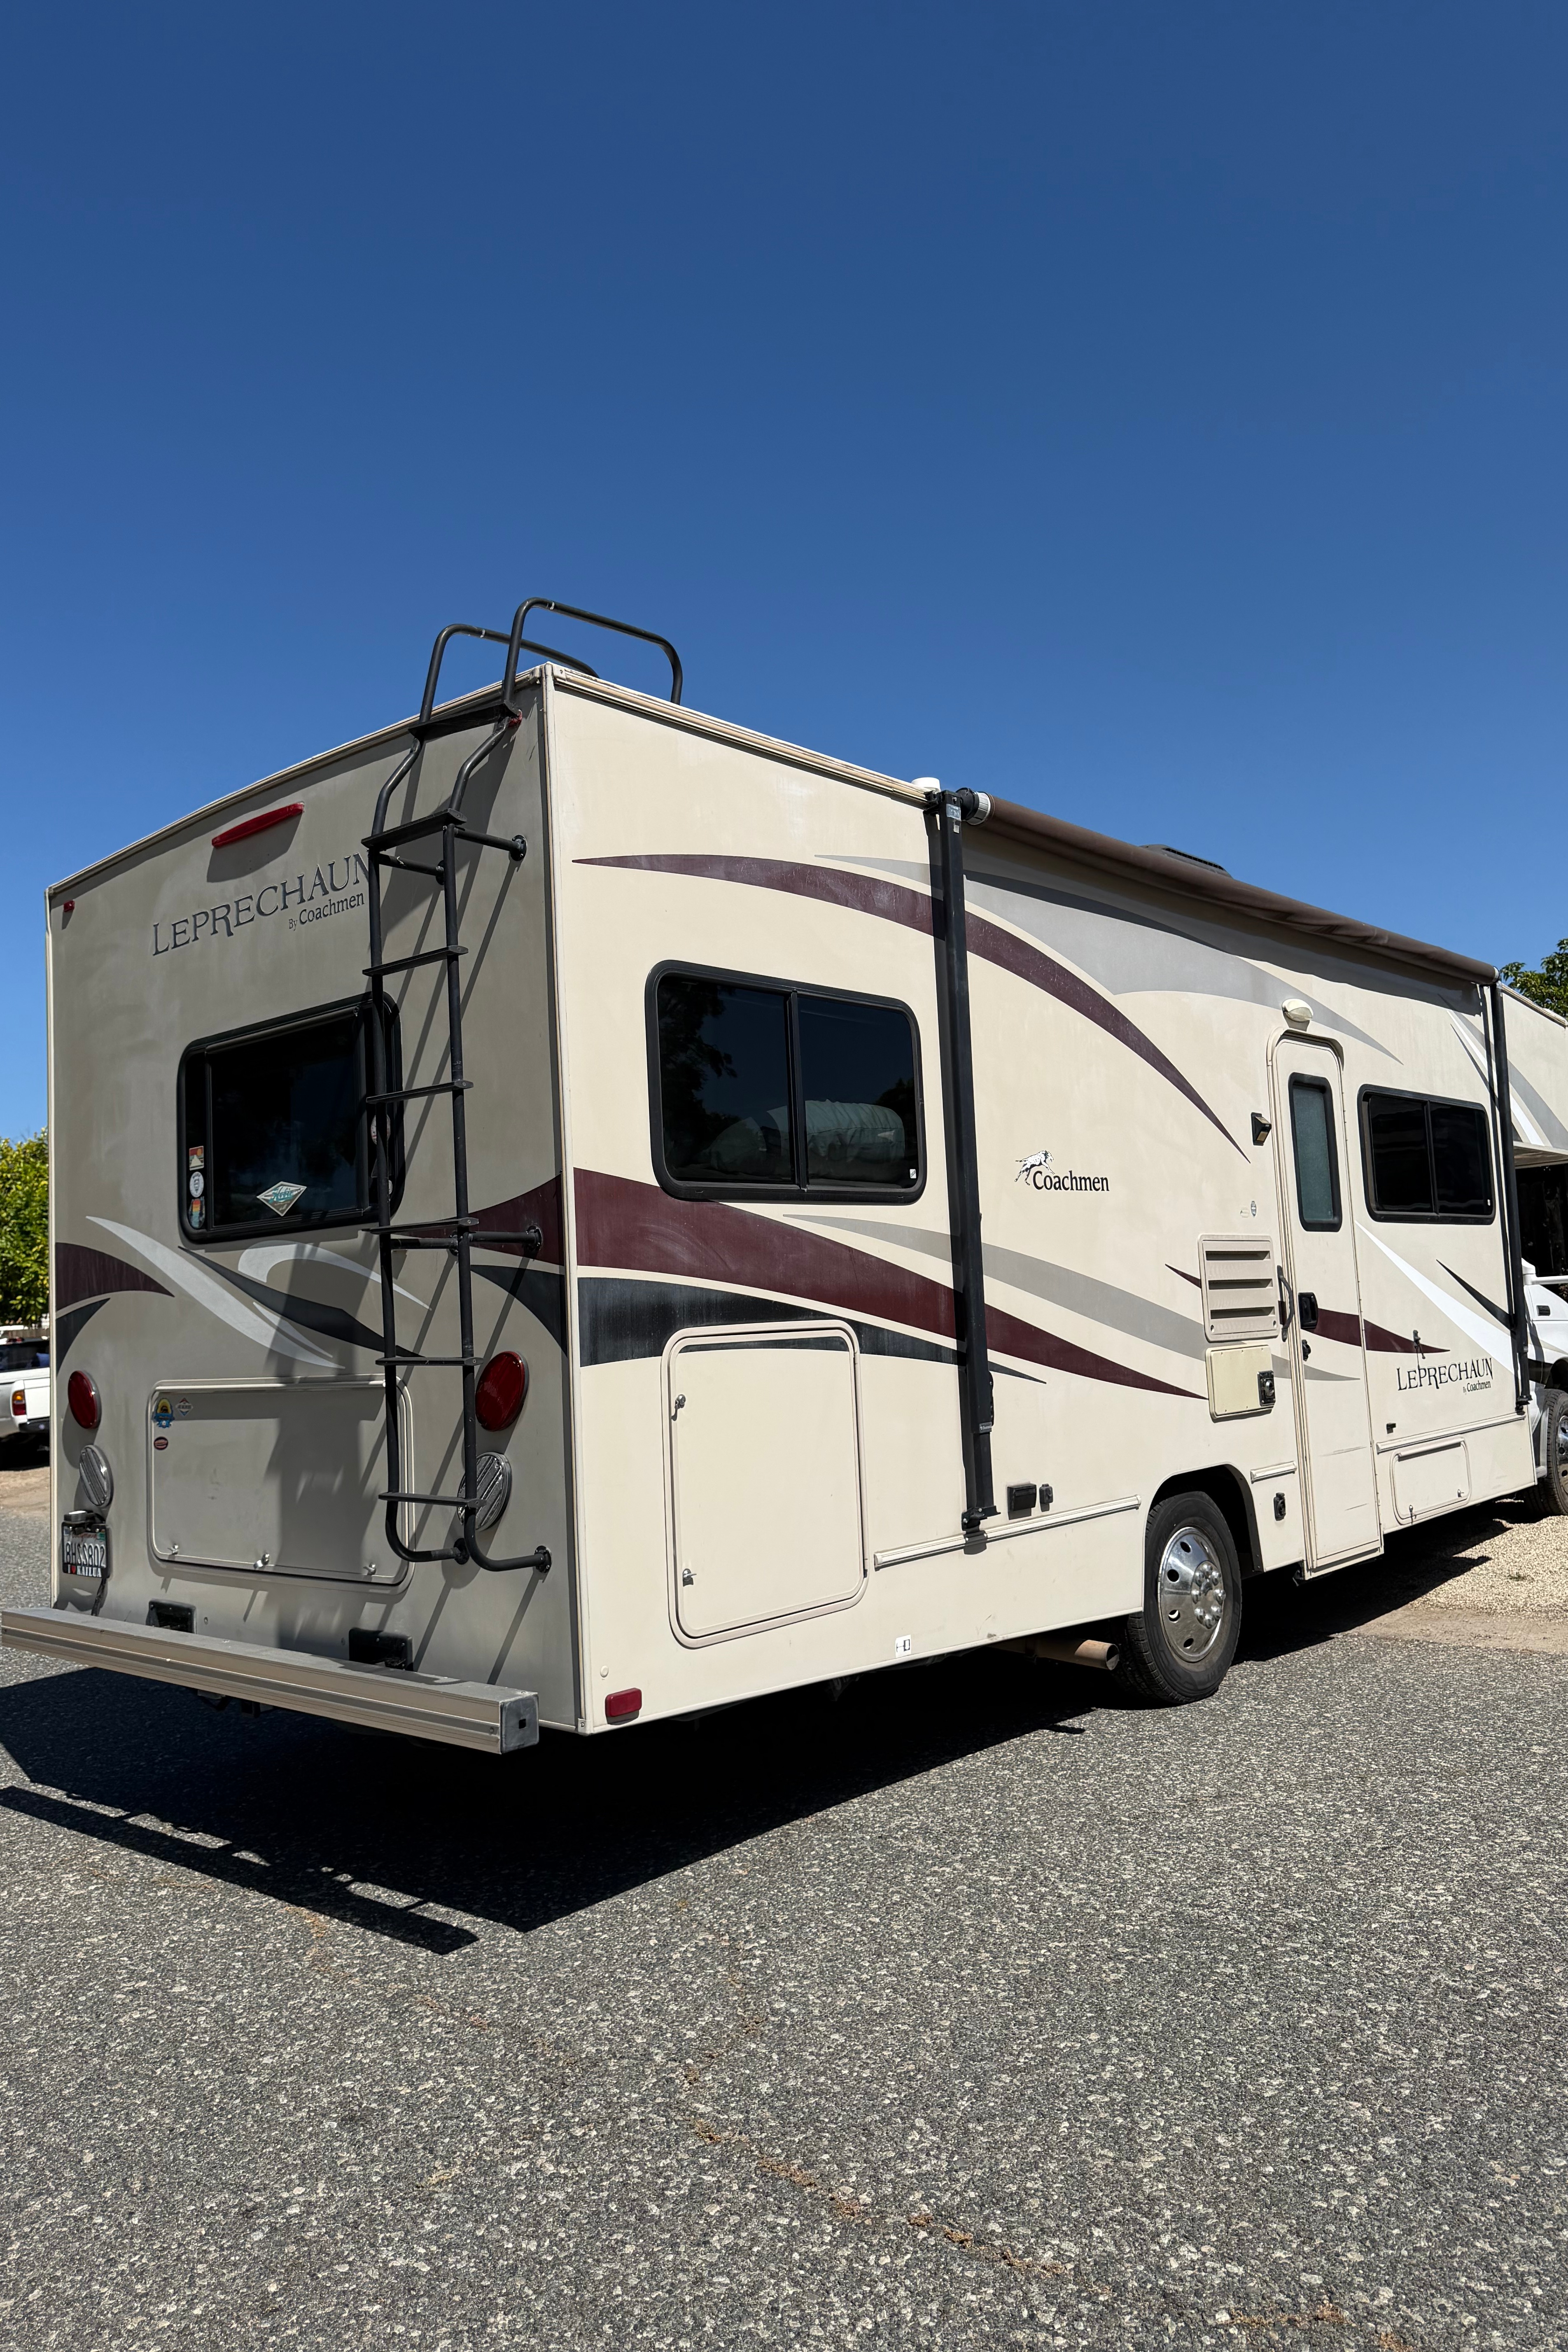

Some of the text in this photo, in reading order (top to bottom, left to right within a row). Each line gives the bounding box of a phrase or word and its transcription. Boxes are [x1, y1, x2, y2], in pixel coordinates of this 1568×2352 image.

[289, 892, 365, 931] By Coachmen
[1033, 1170, 1110, 1191] Coachmen
[1396, 1357, 1493, 1391] LEPRECHAUN
[1467, 1380, 1491, 1392] Coachmen
[77, 1565, 102, 1577] KAILUA
